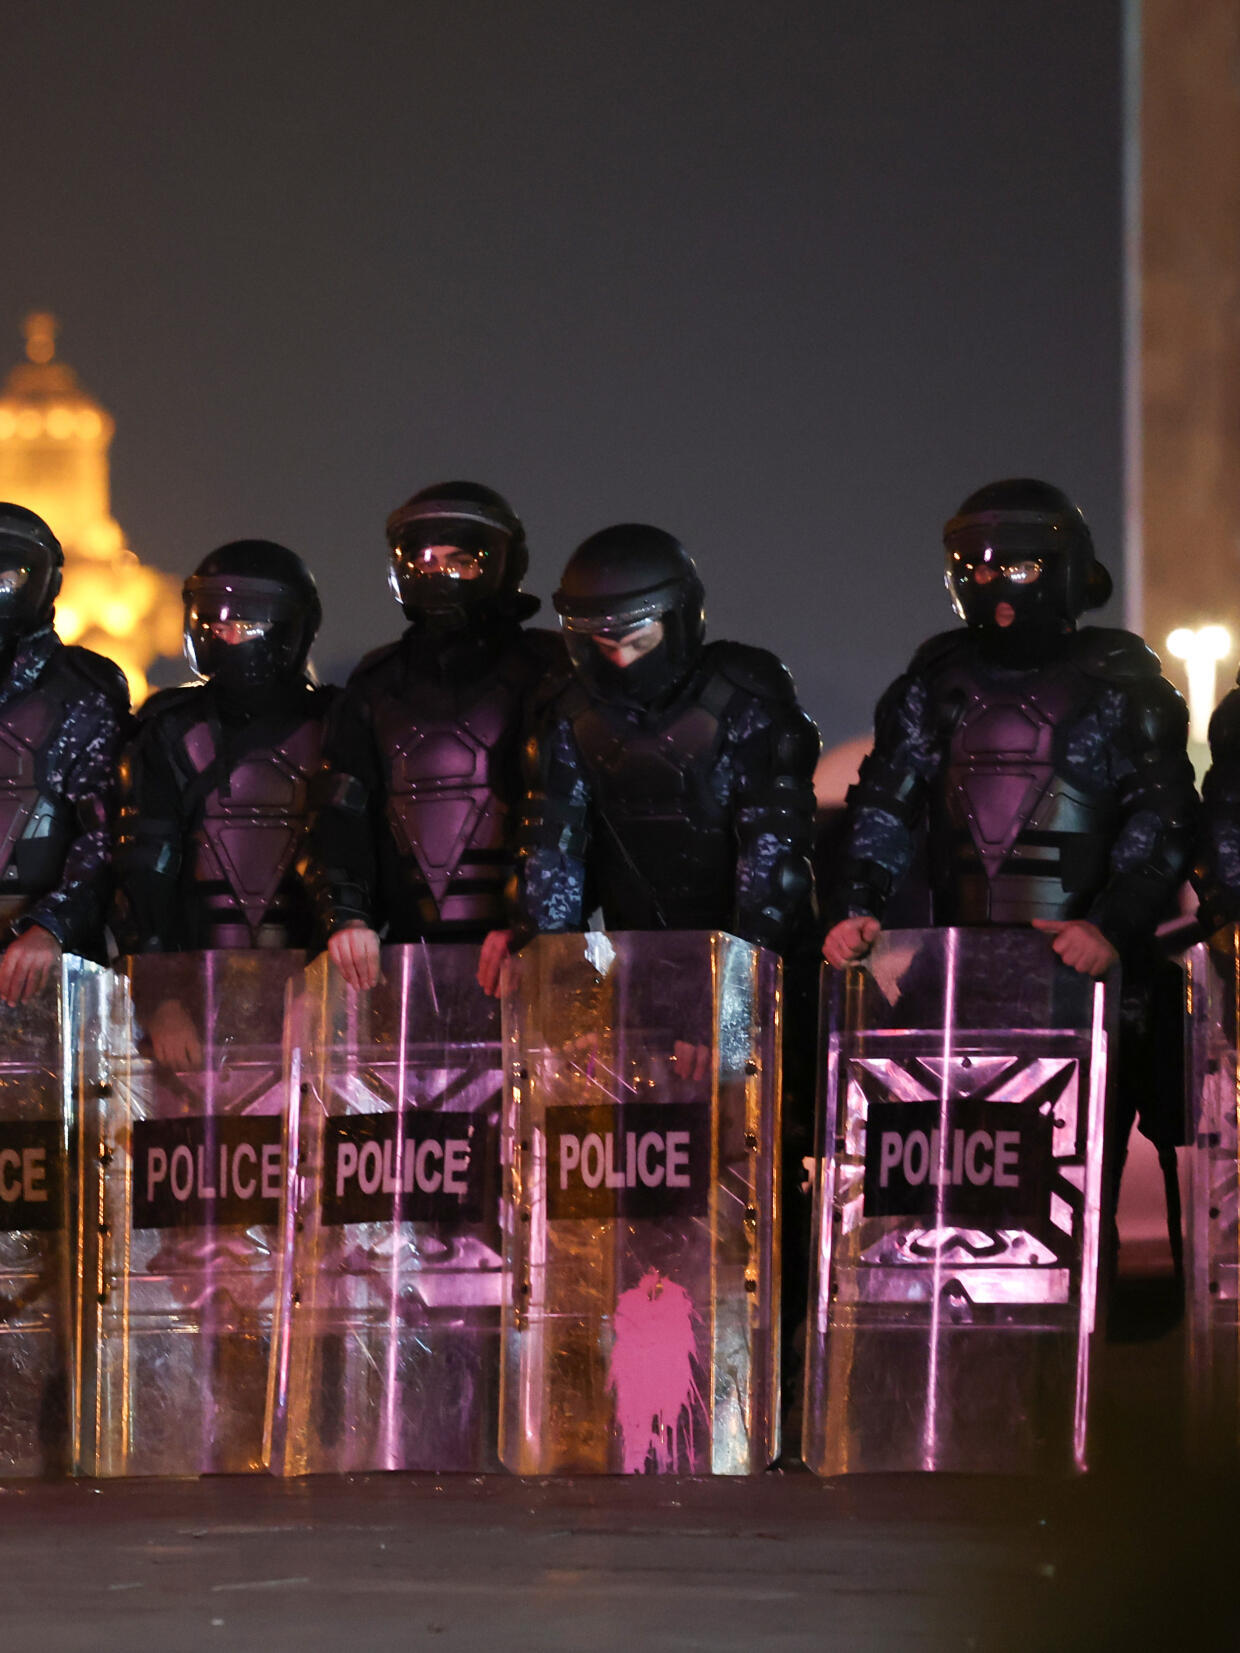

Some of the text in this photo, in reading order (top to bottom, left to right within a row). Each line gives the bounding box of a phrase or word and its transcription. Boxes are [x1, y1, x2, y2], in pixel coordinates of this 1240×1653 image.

[146, 1142, 282, 1201] POLICE
[335, 1139, 469, 1198] POLICE
[556, 1131, 692, 1191] POLICE
[879, 1129, 1021, 1189] POLICE
